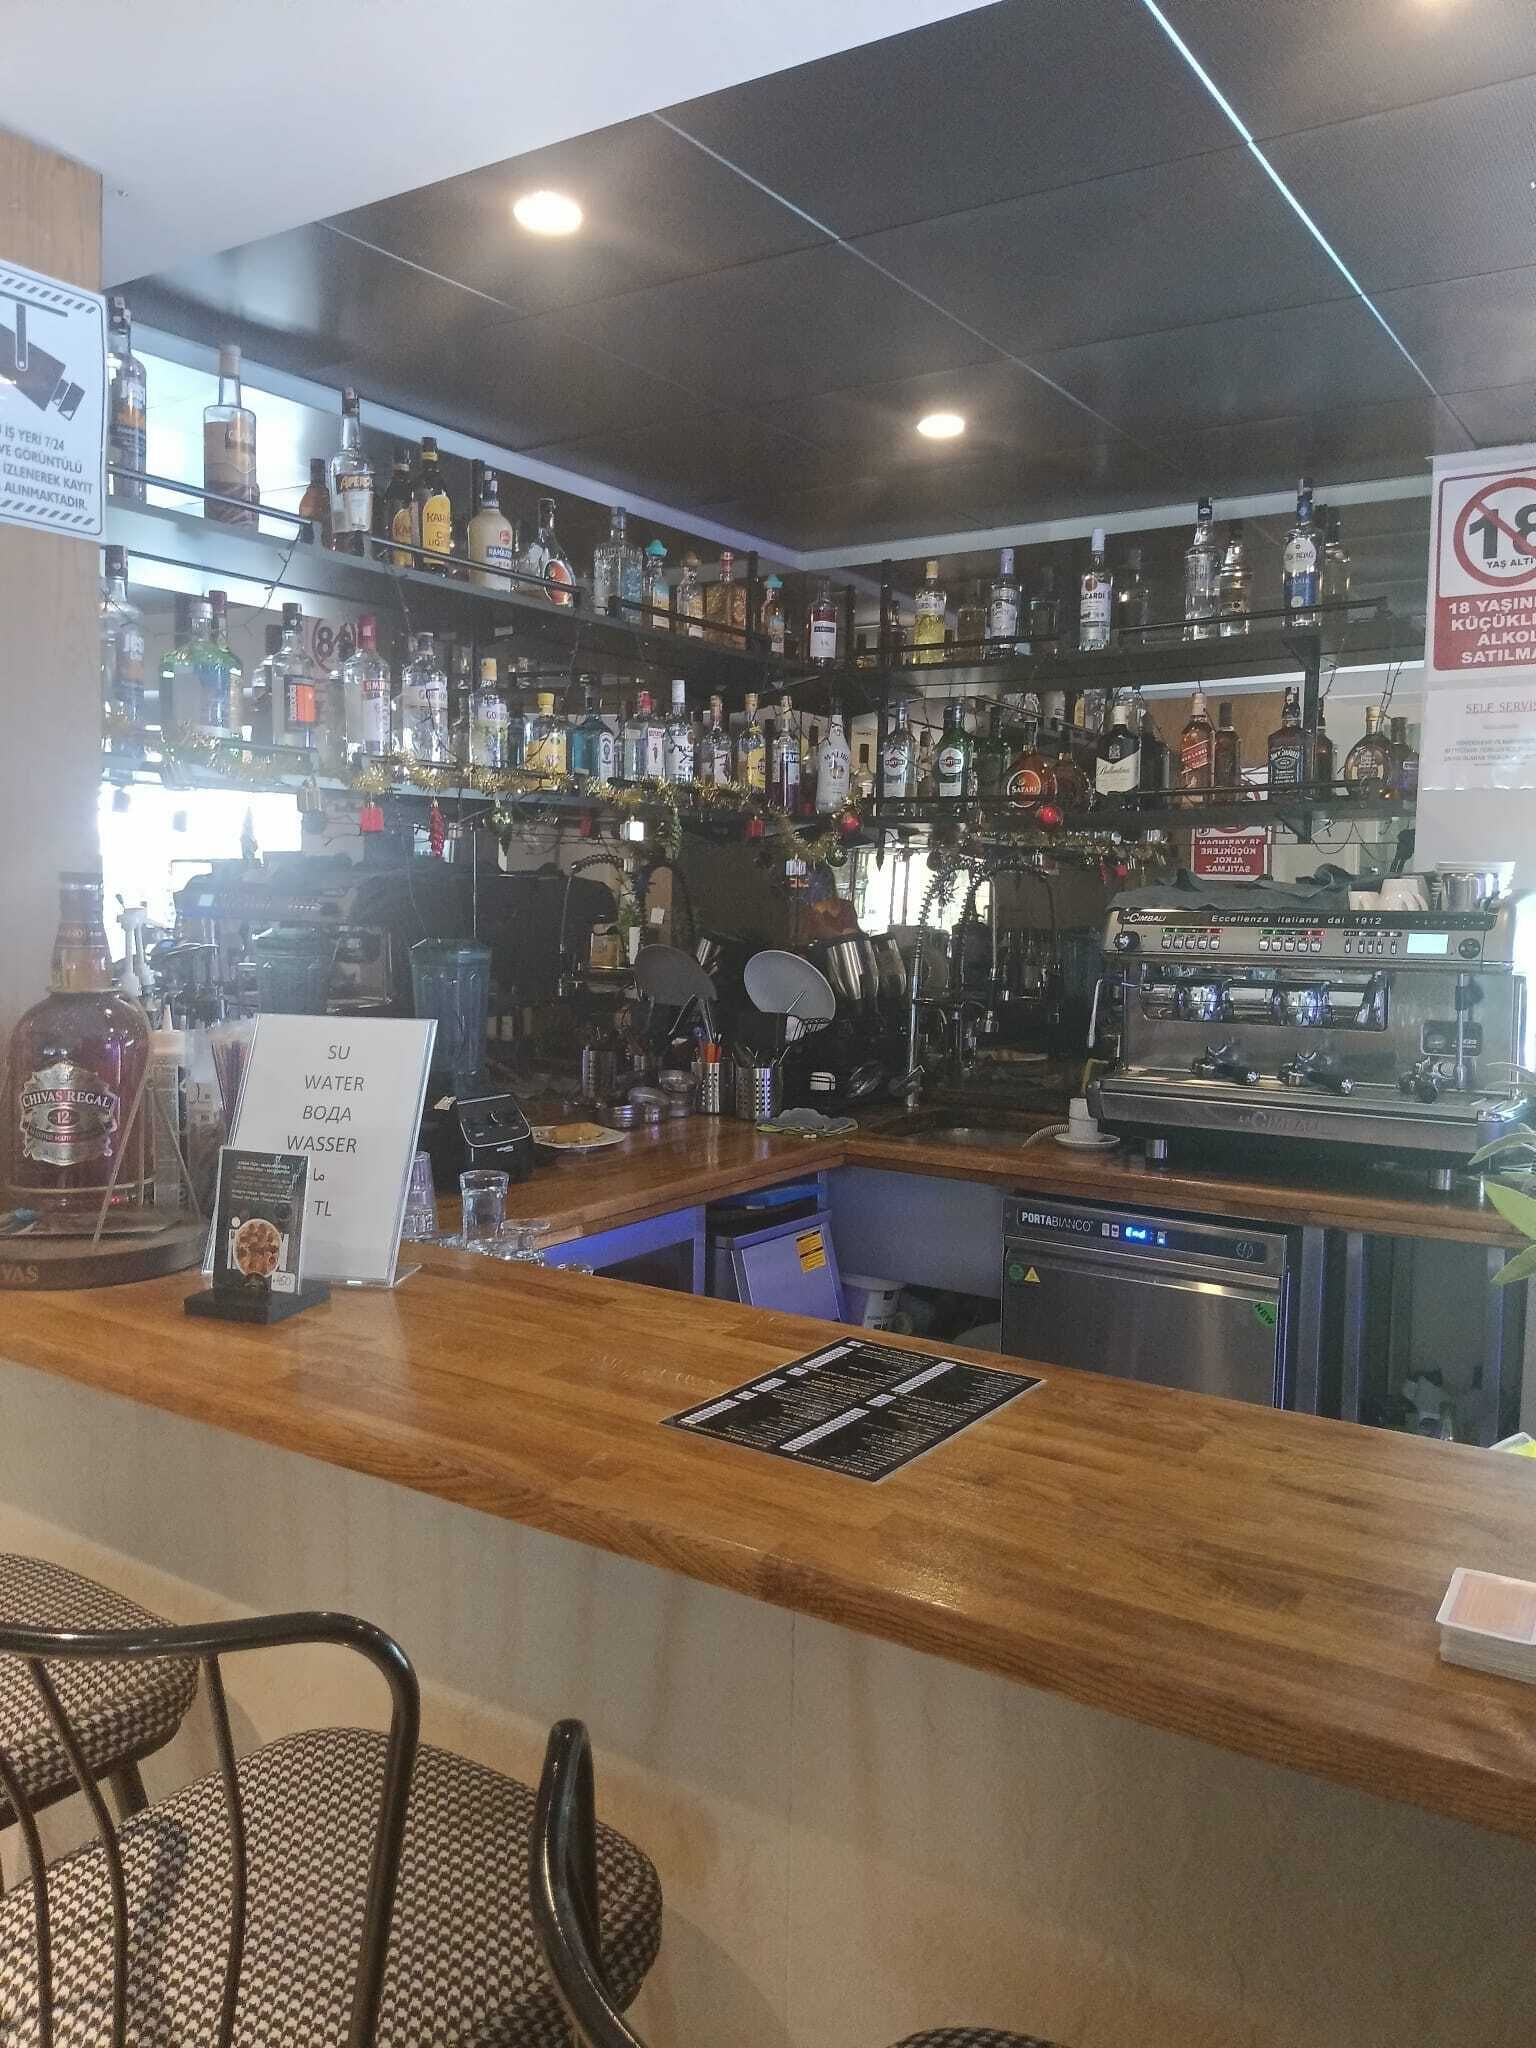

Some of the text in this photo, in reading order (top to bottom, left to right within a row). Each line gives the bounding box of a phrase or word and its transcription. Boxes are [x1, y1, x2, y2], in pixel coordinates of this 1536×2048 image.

[1487, 560, 1508, 569] YAŞ
[1448, 601, 1470, 615] 18
[1211, 915, 1269, 923] Eccellenza
[1355, 917, 1382, 925] 1912
[327, 1045, 350, 1060] SU
[304, 1075, 364, 1091] WATER
[22, 1090, 111, 1108] CHIVAS REGAL
[56, 1110, 70, 1124] 12
[302, 1105, 352, 1124] ВОДА
[286, 1135, 357, 1153] WASSER
[312, 1200, 332, 1217] TL
